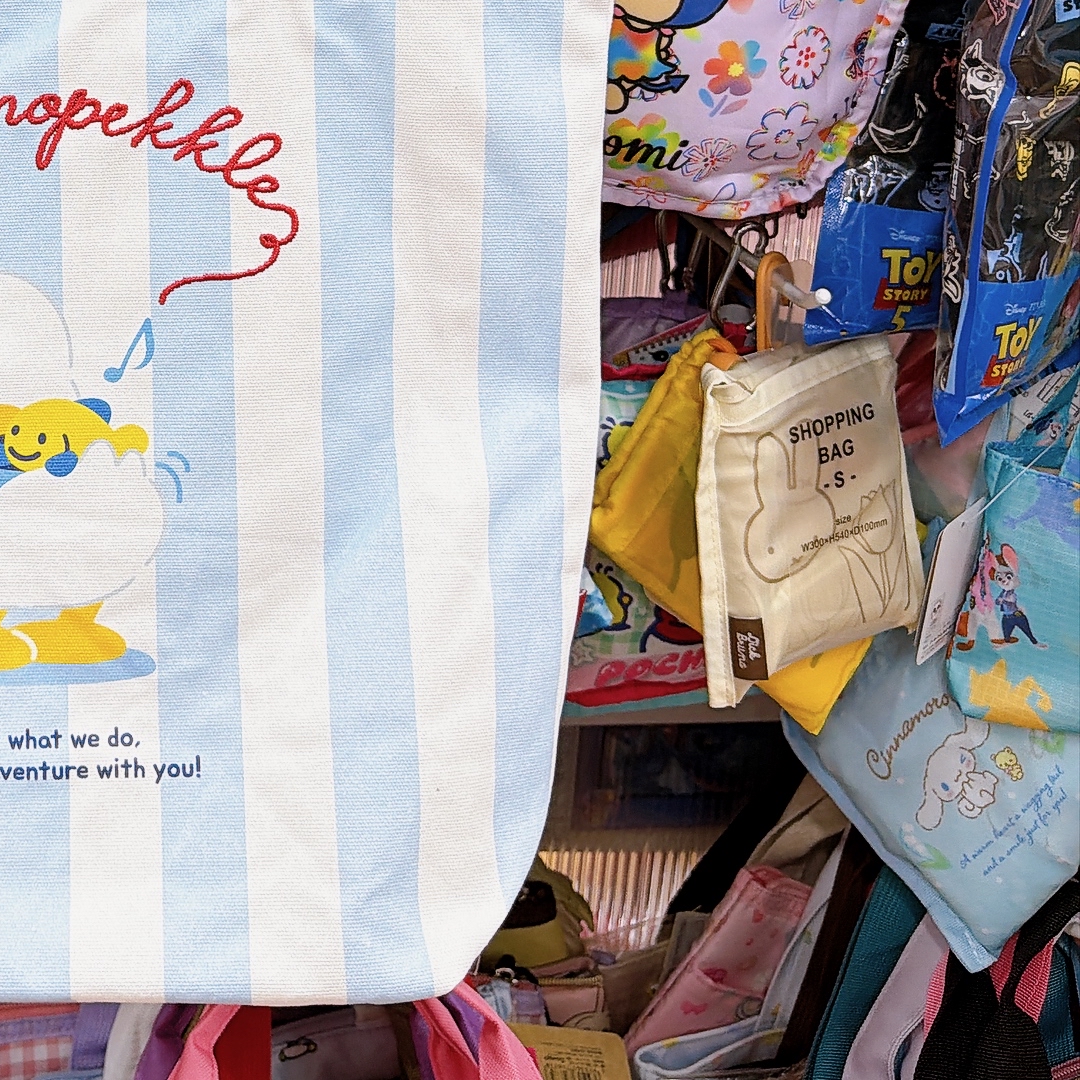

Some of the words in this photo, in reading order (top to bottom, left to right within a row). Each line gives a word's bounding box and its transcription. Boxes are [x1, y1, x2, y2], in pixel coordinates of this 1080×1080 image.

[881, 248, 943, 286] TOY
[883, 287, 930, 302] STORY
[890, 305, 912, 332] 5
[995, 316, 1043, 360] TOY
[788, 403, 875, 444] SHOPPING
[818, 438, 855, 465] BAG
[835, 514, 852, 526] size
[8, 728, 62, 749] what
[71, 733, 100, 749] we
[107, 726, 141, 749] do,
[96, 757, 146, 780] with
[154, 755, 202, 783] you!
[992, 816, 1016, 840] heart
[983, 857, 999, 877] and
